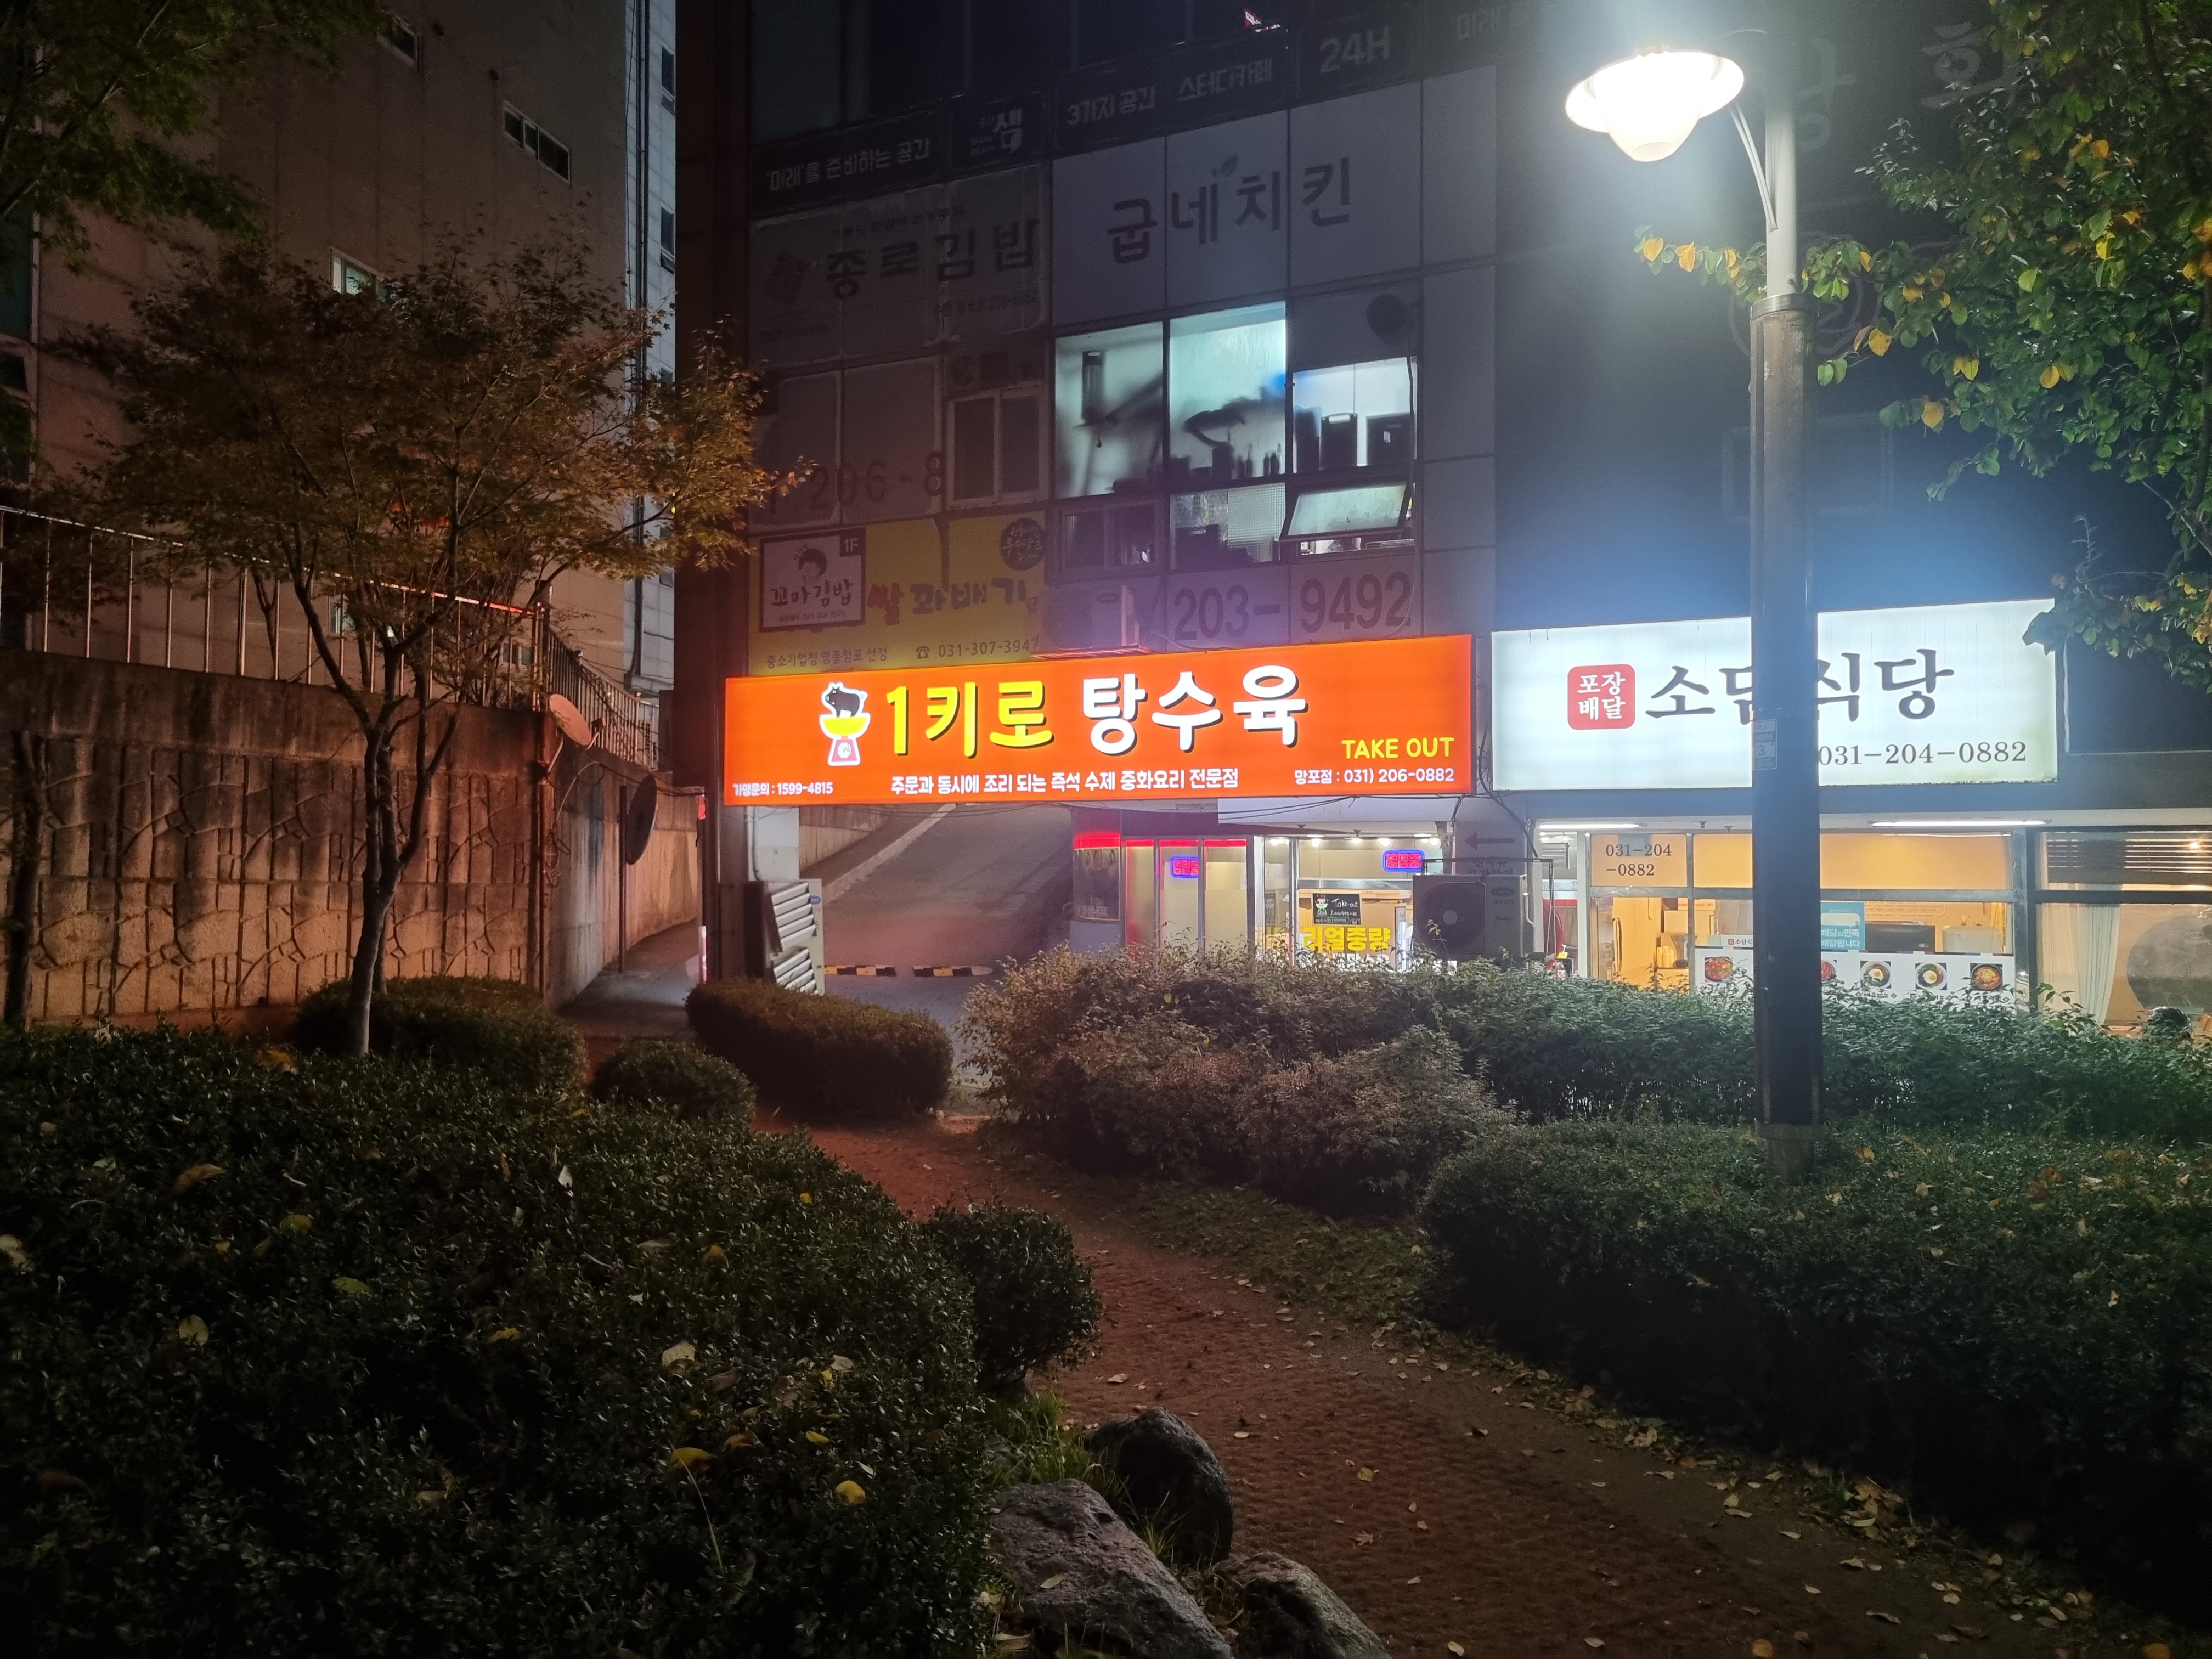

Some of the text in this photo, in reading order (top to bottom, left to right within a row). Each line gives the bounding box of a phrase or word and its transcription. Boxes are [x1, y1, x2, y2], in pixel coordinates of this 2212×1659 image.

[1318, 26, 1390, 74] 24H
[1176, 57, 1273, 103] 스터디카페
[827, 149, 891, 180] 준비하는
[1107, 155, 1352, 264] 굽네치킨
[826, 218, 1040, 300] 종로김밥
[843, 538, 859, 553] 1F
[770, 578, 854, 607] 꼬마김밥
[766, 652, 817, 669] 중소기업청
[866, 646, 887, 662] 선정
[1576, 670, 1626, 696] 포장
[886, 665, 1310, 758] 1키로 탕수육
[1577, 696, 1626, 722] 배달
[1341, 737, 1455, 759] TAKE OUT
[1818, 741, 2028, 766] 031-204-0882
[891, 768, 1239, 795] 주문과 동시에 조리 되는 즉석 수제 중화요리 전문점
[1294, 769, 1333, 785] 망포점
[1343, 768, 1374, 784] 031)
[1378, 768, 1455, 783] 206-0882
[733, 783, 770, 797] 가맹문의
[776, 782, 833, 795] 1599-4815
[1386, 853, 1421, 869] 영업중
[1606, 843, 1672, 857] 031-204
[1174, 860, 1199, 876] 영업중
[1303, 927, 1391, 951] 리얼중량
[1821, 928, 1859, 938] 배달의민족
[1821, 939, 1861, 948] 배달됩니다
